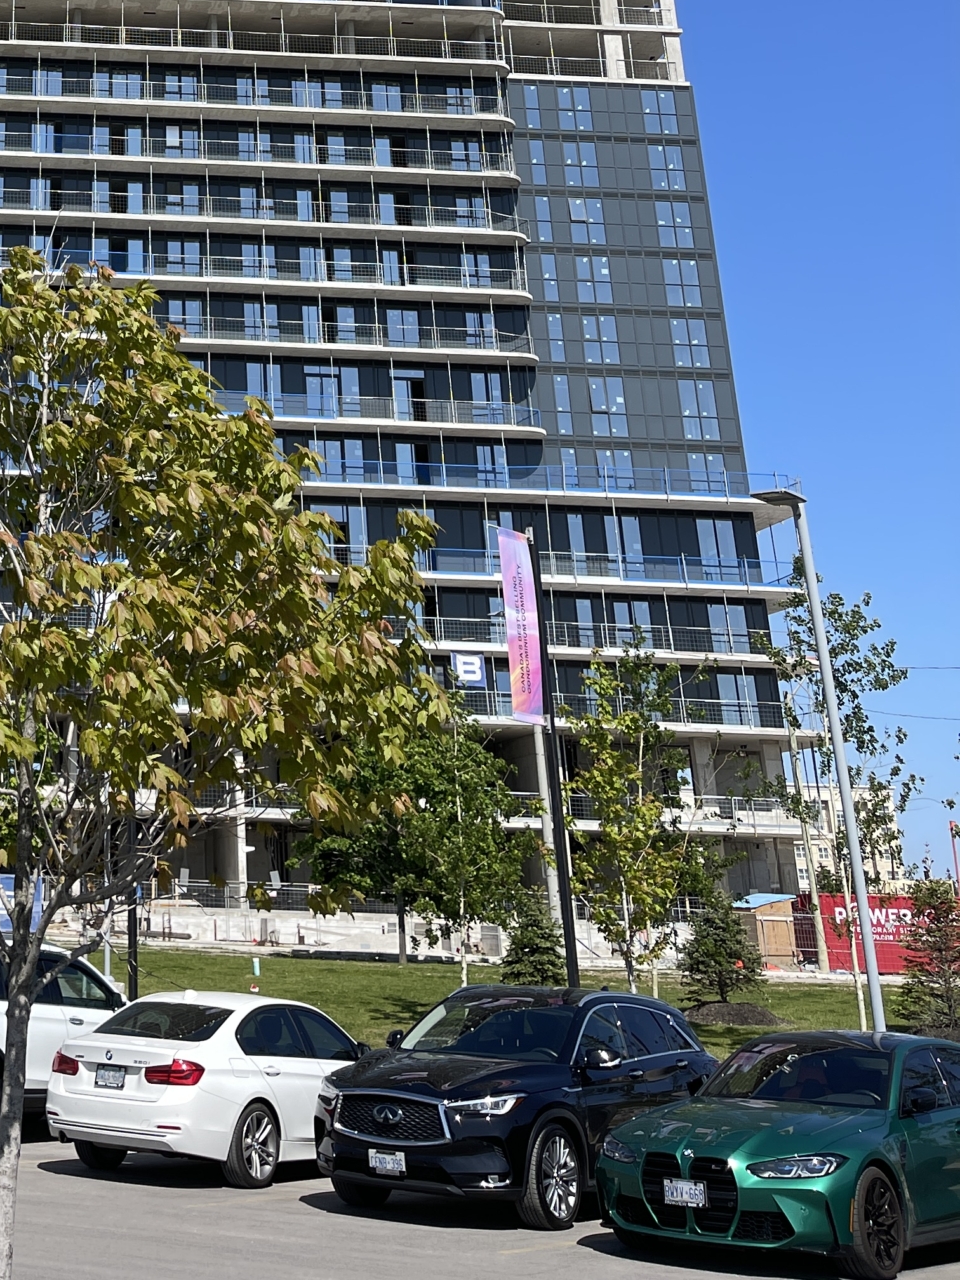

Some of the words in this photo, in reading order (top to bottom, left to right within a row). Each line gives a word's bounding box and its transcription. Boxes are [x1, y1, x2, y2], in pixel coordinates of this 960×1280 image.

[512, 576, 522, 642] BEST-SELLING
[456, 653, 482, 681] B
[518, 644, 527, 693] CANADA'S
[522, 624, 532, 694] CONDOMINIUM
[834, 902, 913, 926] PWER
